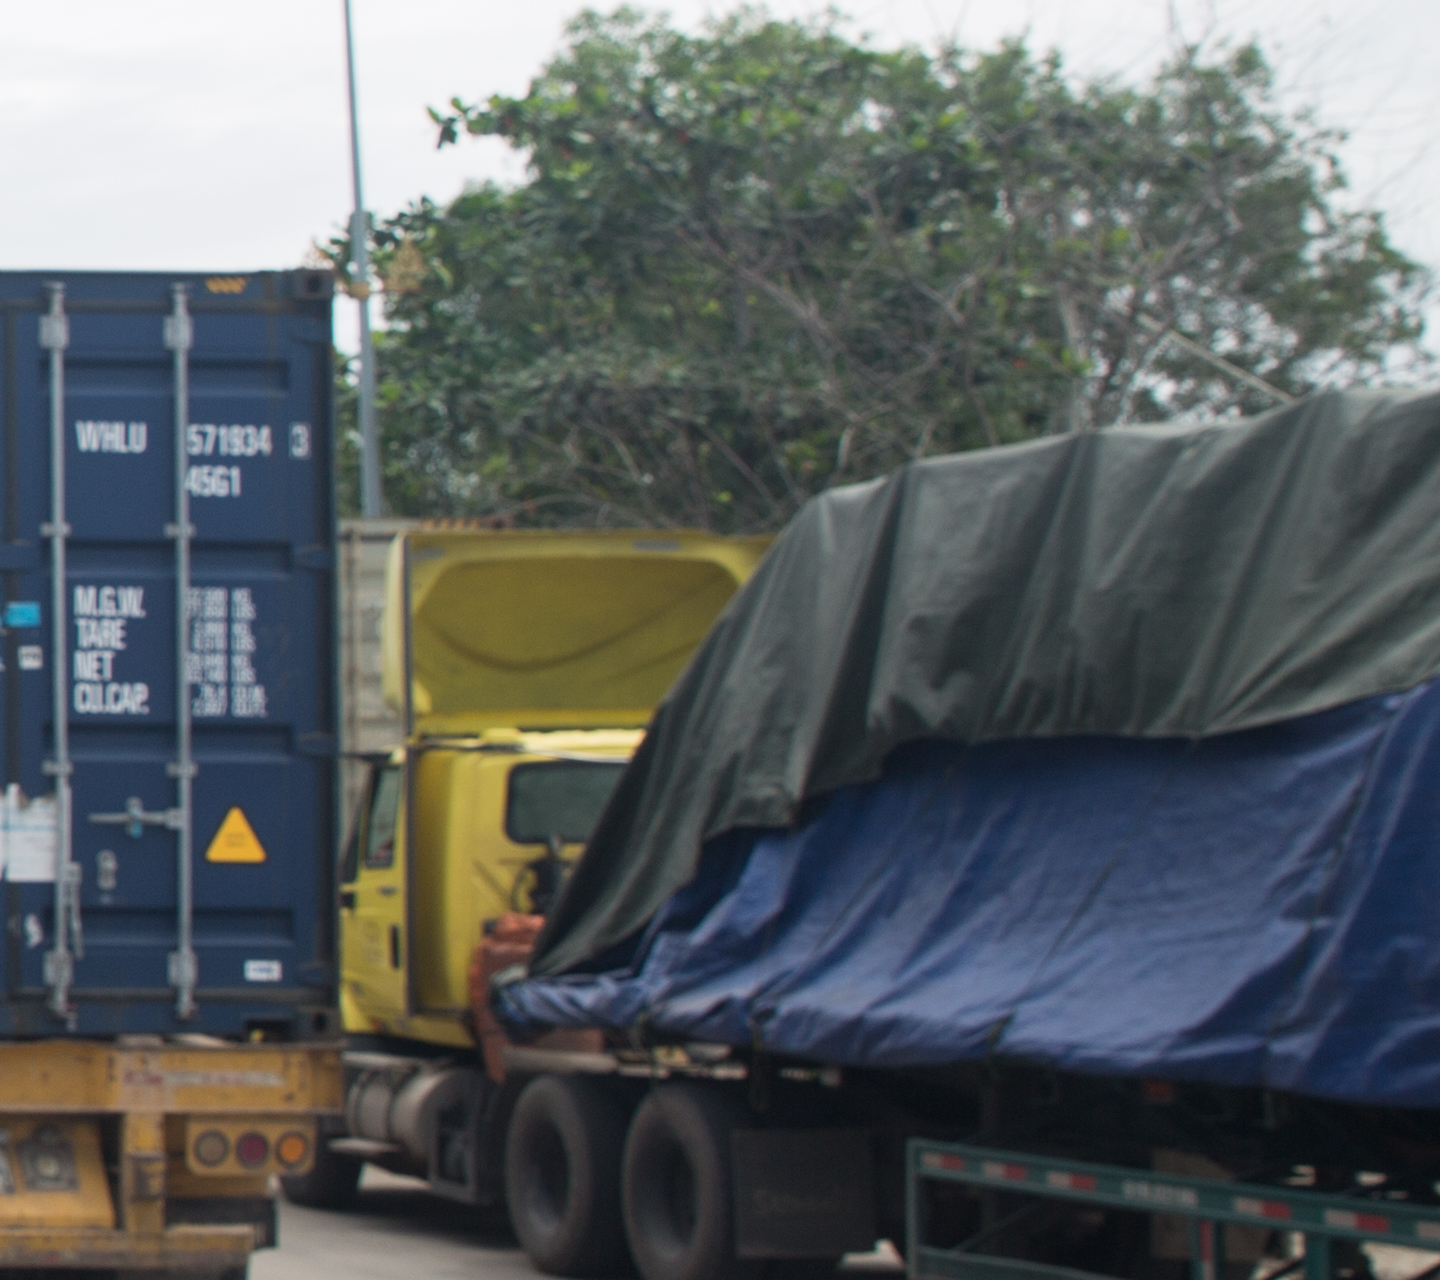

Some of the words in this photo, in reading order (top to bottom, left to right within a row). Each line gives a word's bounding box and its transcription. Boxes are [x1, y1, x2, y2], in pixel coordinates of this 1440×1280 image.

[75, 420, 147, 453] WHLU
[291, 424, 310, 457] 3
[73, 618, 127, 650] TARE
[73, 650, 117, 682] NET
